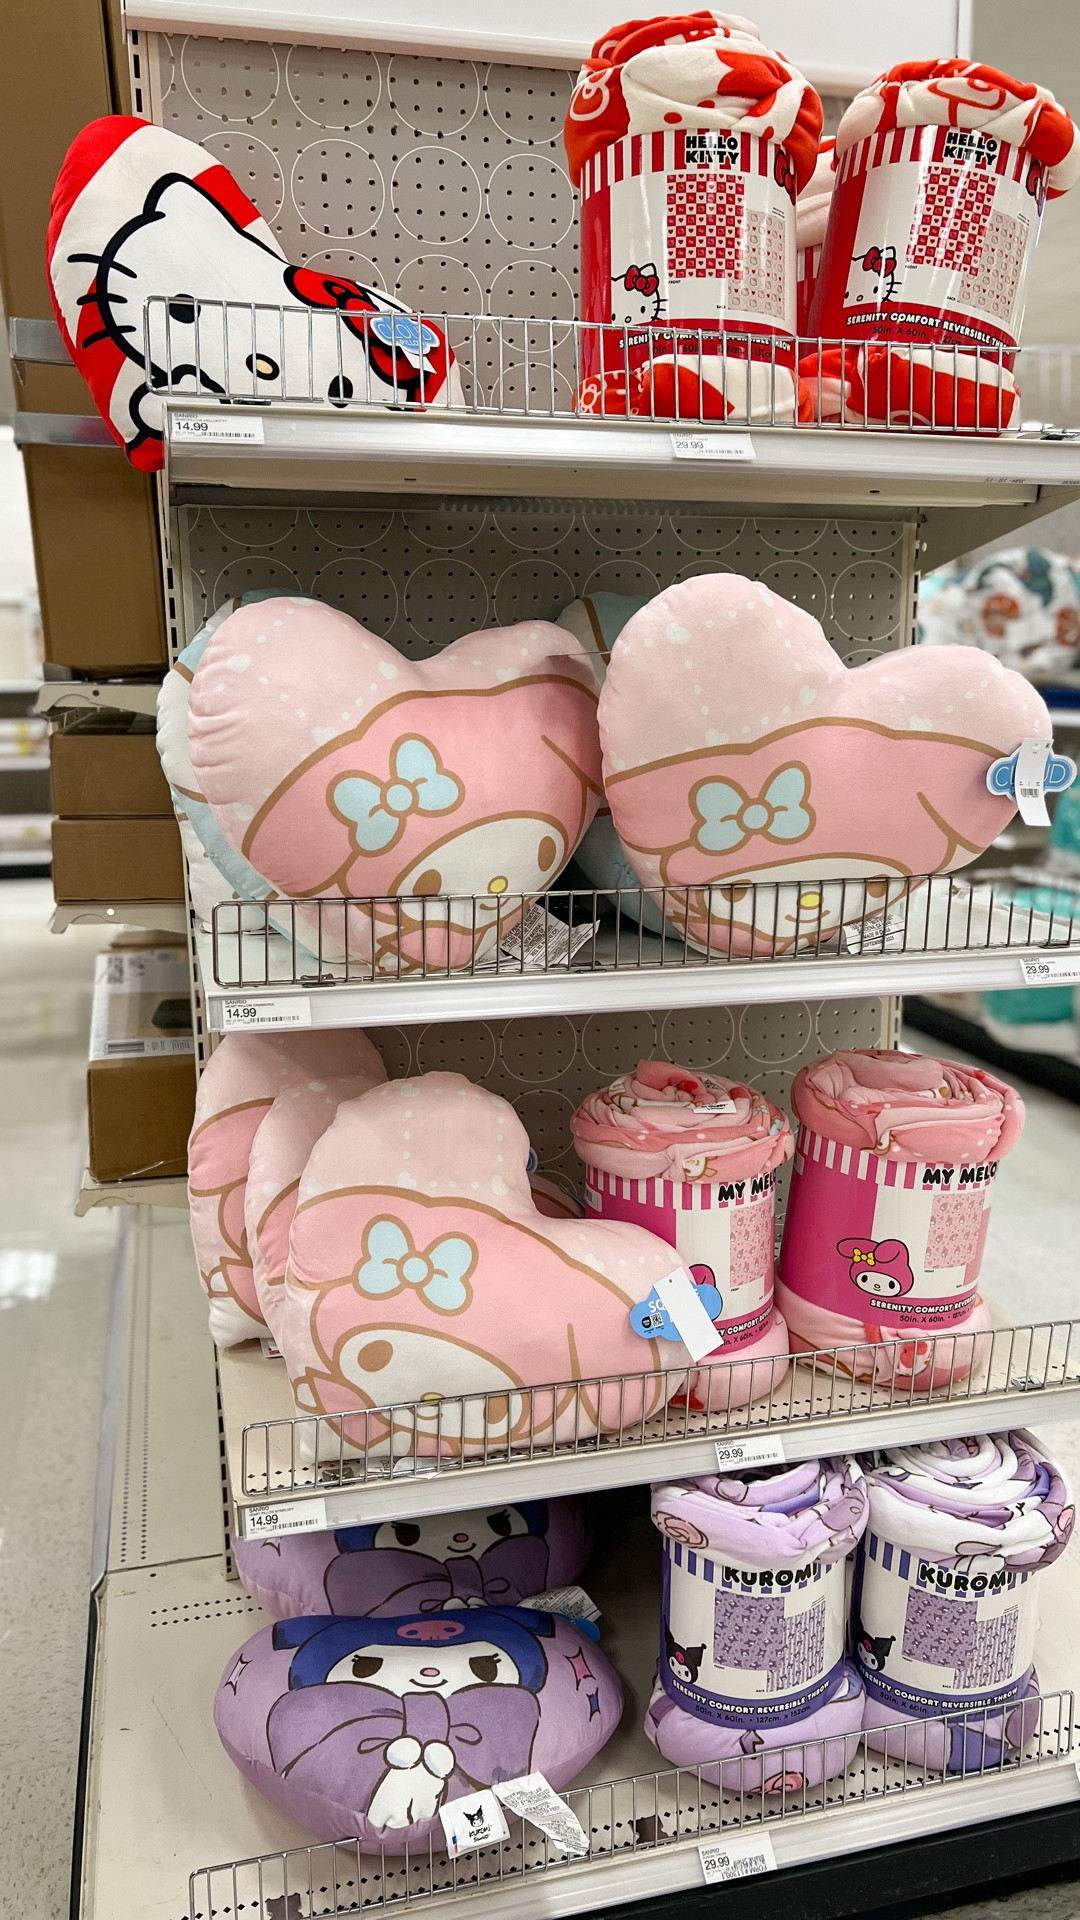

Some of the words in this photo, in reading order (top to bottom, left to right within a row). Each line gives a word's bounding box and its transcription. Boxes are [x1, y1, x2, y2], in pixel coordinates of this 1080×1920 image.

[686, 136, 738, 150] HELLO
[946, 132, 998, 152] HELLO
[686, 151, 739, 165] KITTY
[943, 146, 998, 166] KITTY
[847, 312, 888, 326] SERENITY
[890, 312, 941, 328] COMFORT
[942, 320, 991, 344] REVERSIBLE
[176, 422, 208, 431] 14.99
[675, 441, 704, 449] 29.99
[1025, 965, 1049, 974] 29.99
[226, 1008, 256, 1018] 14.99
[923, 1168, 954, 1184] MY
[718, 1182, 745, 1201] MY
[870, 1299, 912, 1313] SERENITY
[915, 1304, 953, 1314] COMFORT
[727, 1317, 758, 1335] COMFORT
[719, 1448, 743, 1460] 29.99
[250, 1514, 278, 1527] 14.99
[724, 1562, 818, 1587] KUROMI
[920, 1564, 1013, 1591] KUROMI
[672, 1679, 707, 1706] SERENITY
[708, 1700, 754, 1714] COMFORT
[757, 1697, 806, 1714] REVERSIBLE
[806, 1680, 830, 1702] THROW
[894, 1688, 939, 1707] COMFORT
[942, 1698, 991, 1709] REVERSIBLE
[993, 1686, 1018, 1703] THROW
[908, 1703, 930, 1714] 60in.
[724, 1714, 745, 1724] 60in.
[756, 1716, 781, 1724] 127cm.
[701, 1847, 720, 1856] SANRIO
[704, 1856, 730, 1870] 29.99
